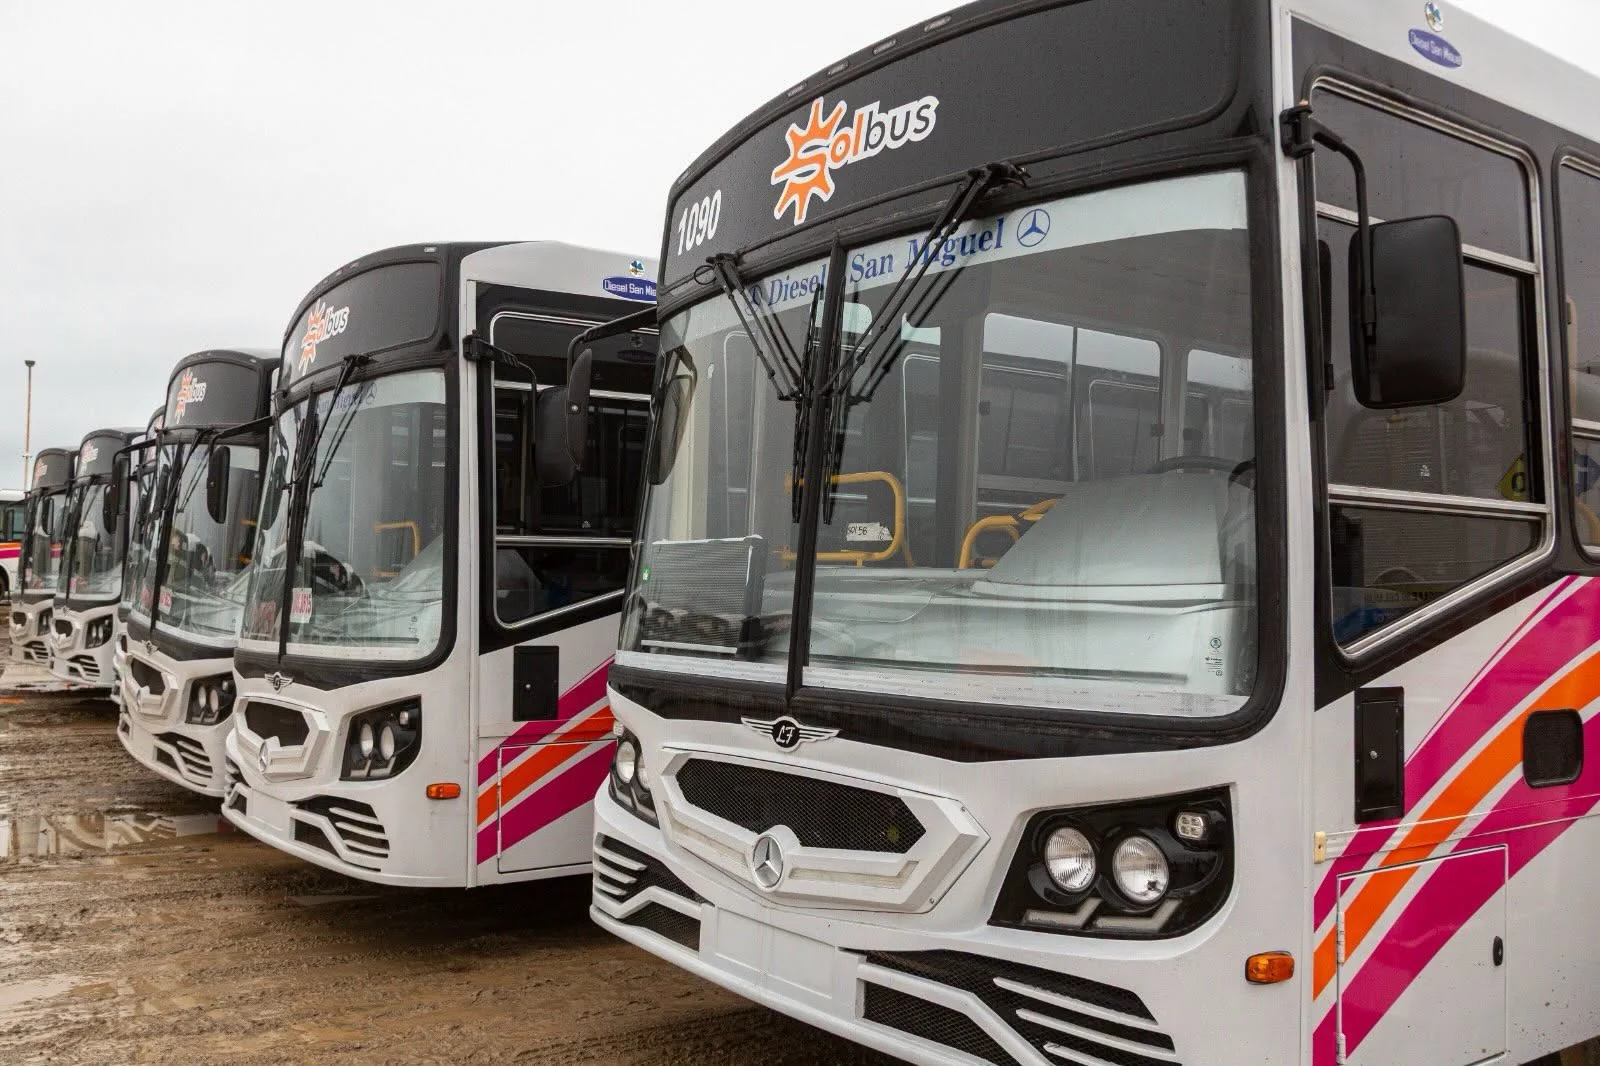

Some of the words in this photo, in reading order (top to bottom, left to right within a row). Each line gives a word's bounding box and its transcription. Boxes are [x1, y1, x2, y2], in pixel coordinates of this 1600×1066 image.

[771, 97, 939, 226] Solbus
[678, 189, 722, 256] 1090
[604, 280, 627, 293] Diesel
[629, 283, 644, 295] San
[768, 263, 827, 307] Diesel
[850, 252, 894, 284] San
[905, 217, 1005, 269] Miguel
